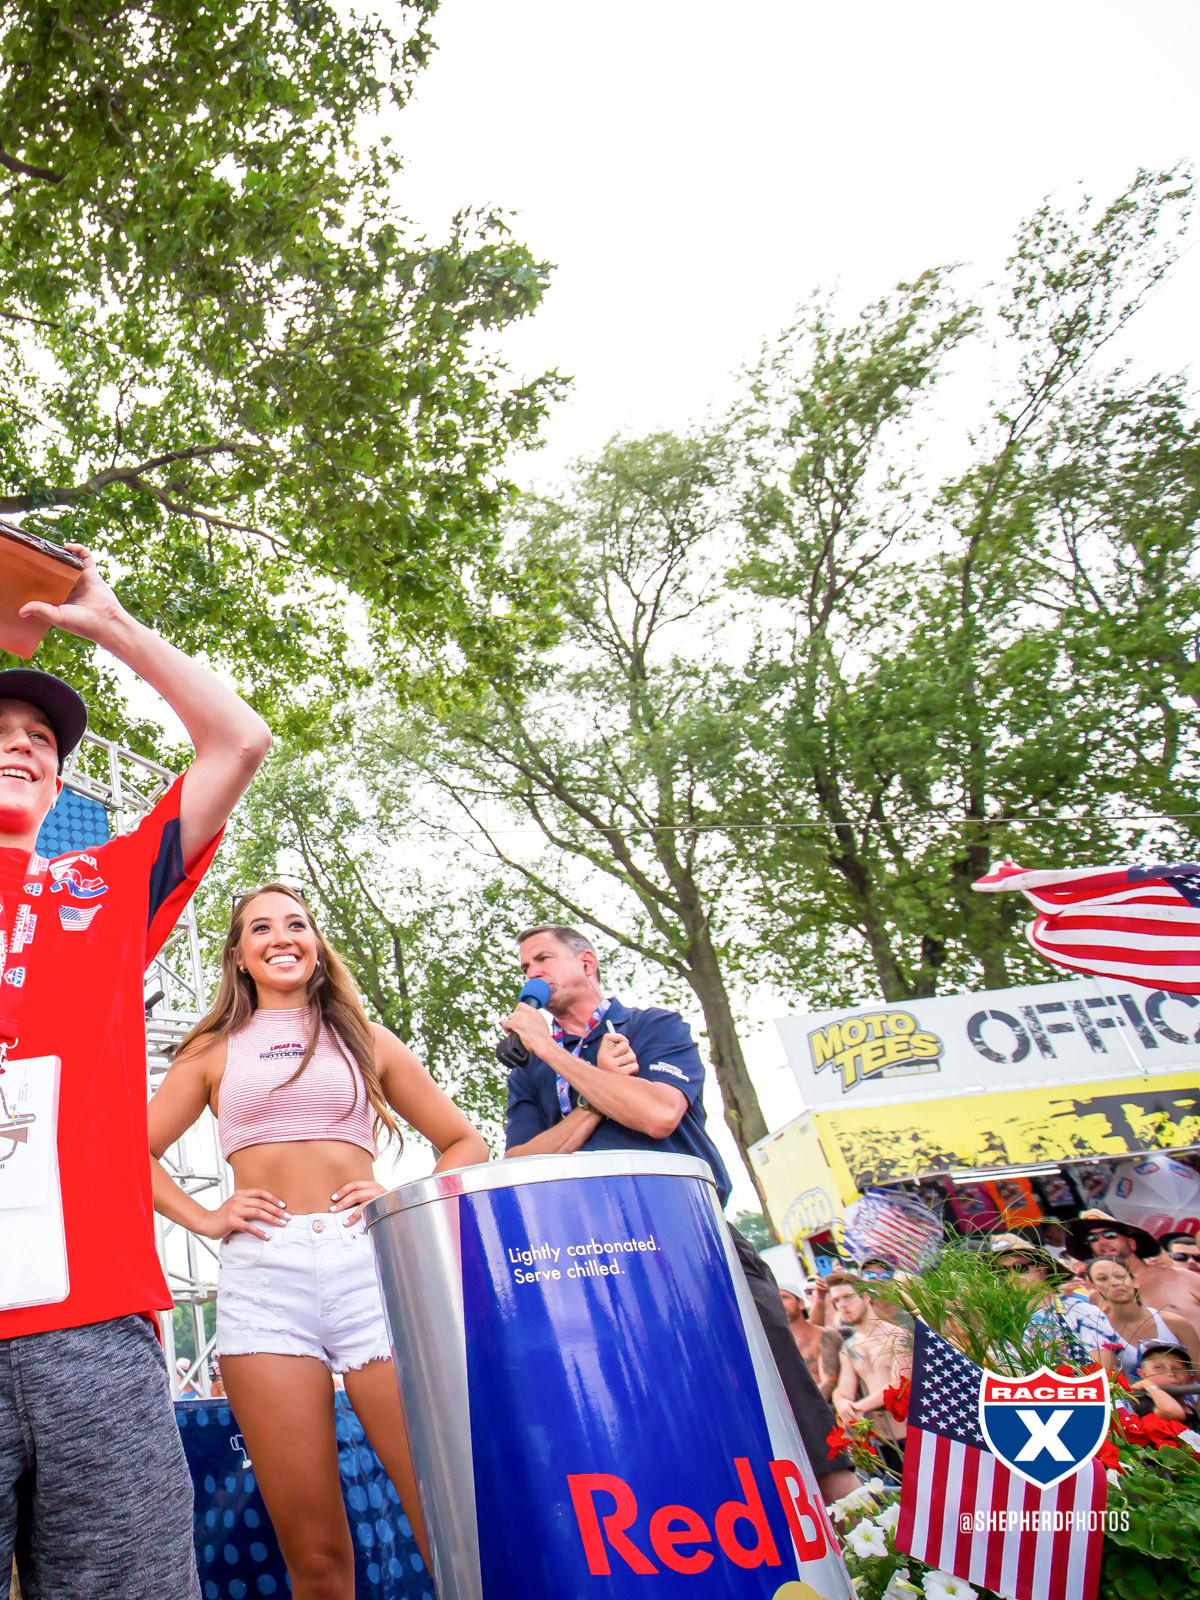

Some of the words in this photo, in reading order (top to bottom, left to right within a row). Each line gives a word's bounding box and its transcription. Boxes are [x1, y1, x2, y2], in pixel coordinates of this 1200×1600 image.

[810, 1013, 917, 1068] MOTO
[835, 1034, 941, 1088] TEES
[508, 1242, 561, 1266] Lightly
[567, 1234, 661, 1257] carbonated.
[514, 1268, 562, 1284] Serve
[566, 1258, 625, 1278] chilled.
[567, 1457, 782, 1576] Red
